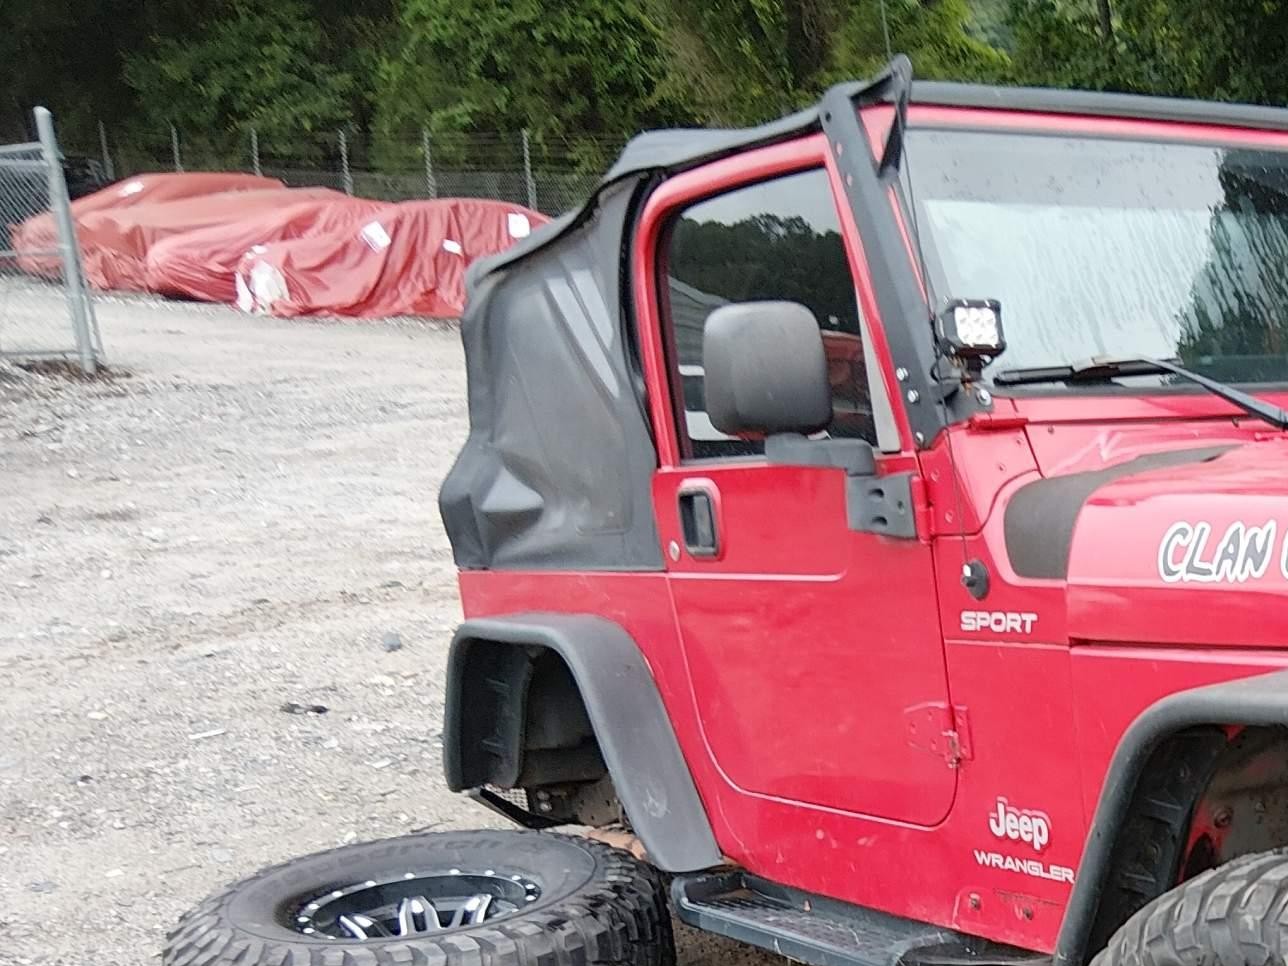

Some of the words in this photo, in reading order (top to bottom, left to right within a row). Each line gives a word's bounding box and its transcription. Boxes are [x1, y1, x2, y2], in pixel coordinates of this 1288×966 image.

[1158, 519, 1276, 584] CLAN
[960, 611, 1038, 634] SPORT
[988, 799, 1050, 850] Jeep
[974, 850, 1076, 884] WRANGLER
